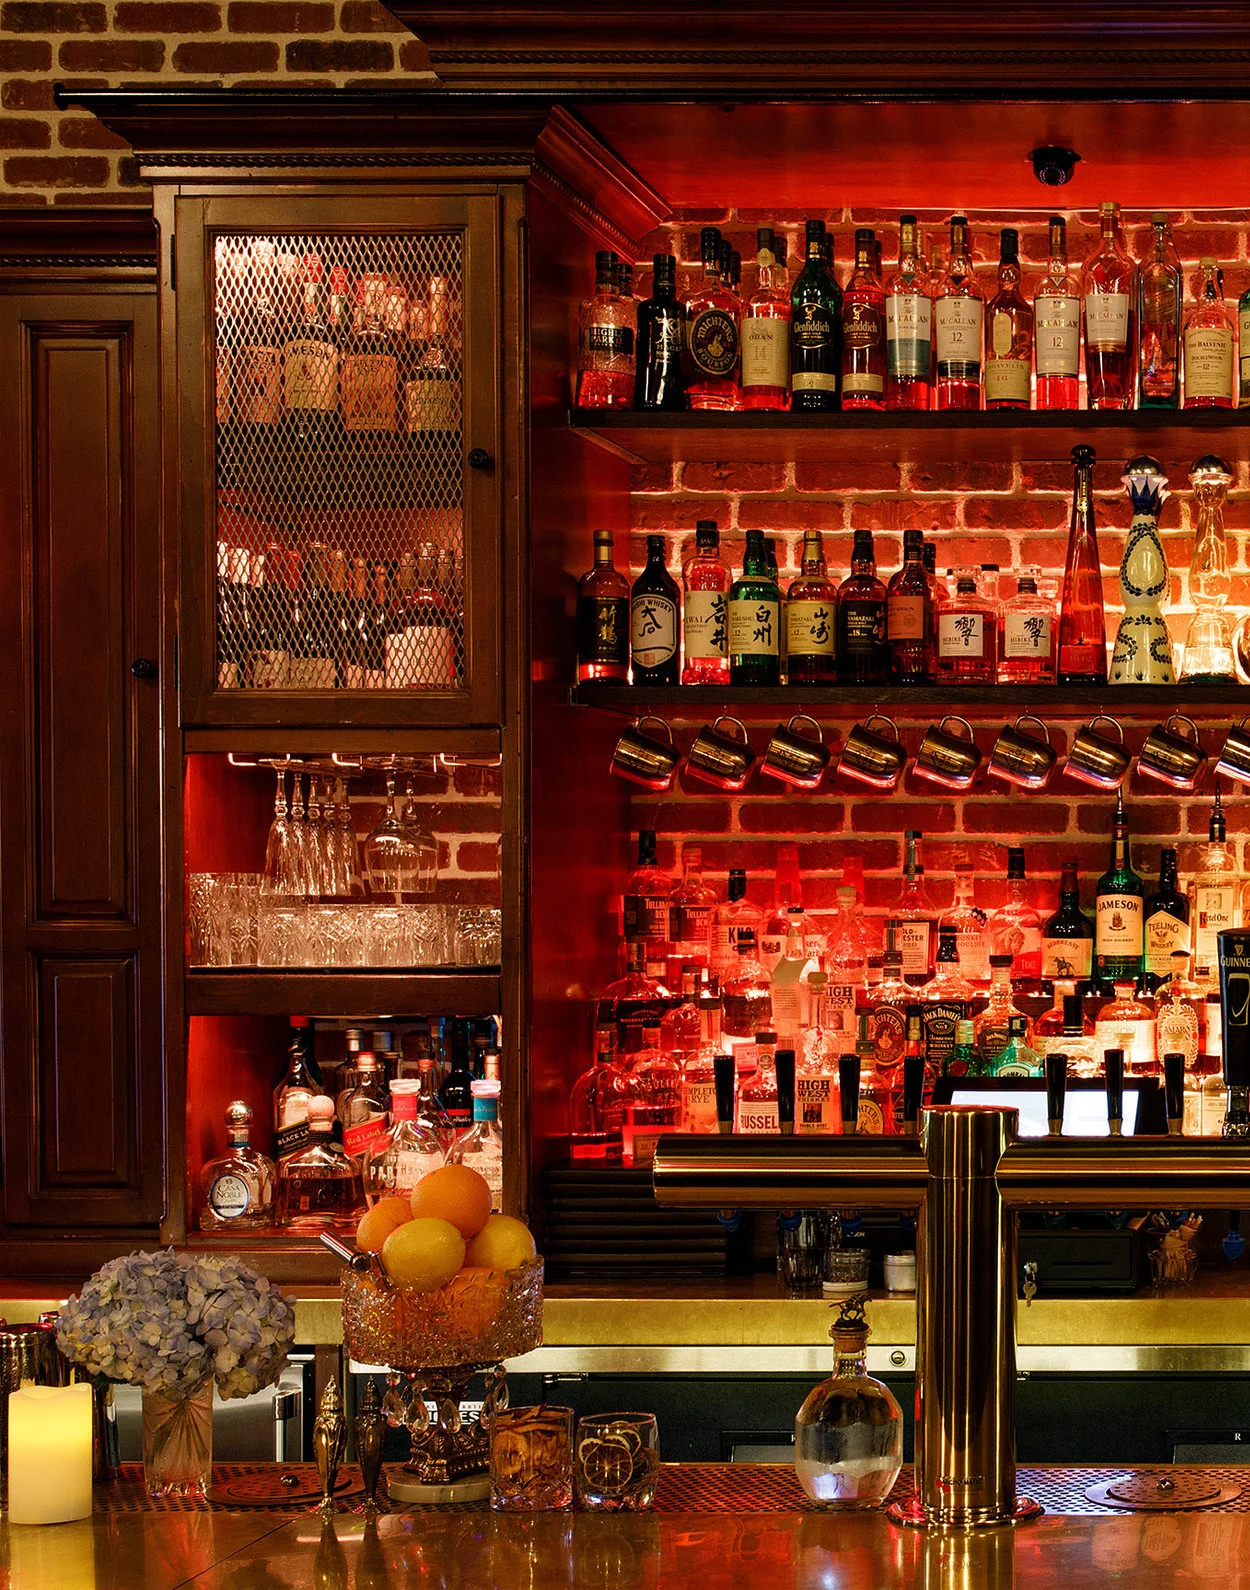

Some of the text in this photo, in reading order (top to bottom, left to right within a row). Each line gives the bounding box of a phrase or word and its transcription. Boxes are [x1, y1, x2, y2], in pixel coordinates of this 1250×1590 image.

[793, 320, 830, 333] Glenfiddich
[843, 321, 878, 333] Glenfiddich
[1037, 319, 1078, 329] MACALLAN
[748, 334, 774, 342] OBAN
[952, 331, 963, 342] 12
[1052, 336, 1064, 348] 12
[646, 598, 673, 613] WHISKY
[752, 604, 773, 647] 白州
[852, 629, 861, 637] 18
[1098, 900, 1139, 912] JAMESON
[1216, 914, 1229, 922] One
[1148, 922, 1180, 934] TEELING
[902, 934, 924, 942] ESTER
[1047, 940, 1080, 950] REDBREAST
[826, 986, 854, 997] IGH
[923, 1008, 962, 1023] JACK DANIEL'S
[798, 1080, 830, 1091] HIGH
[798, 1090, 830, 1098] WEST
[740, 1115, 778, 1130] RUSSEL
[277, 1132, 300, 1146] BLACK
[347, 1128, 381, 1146] Red Label
[218, 1184, 240, 1192] CASA
[216, 1191, 241, 1200] NOBLE
